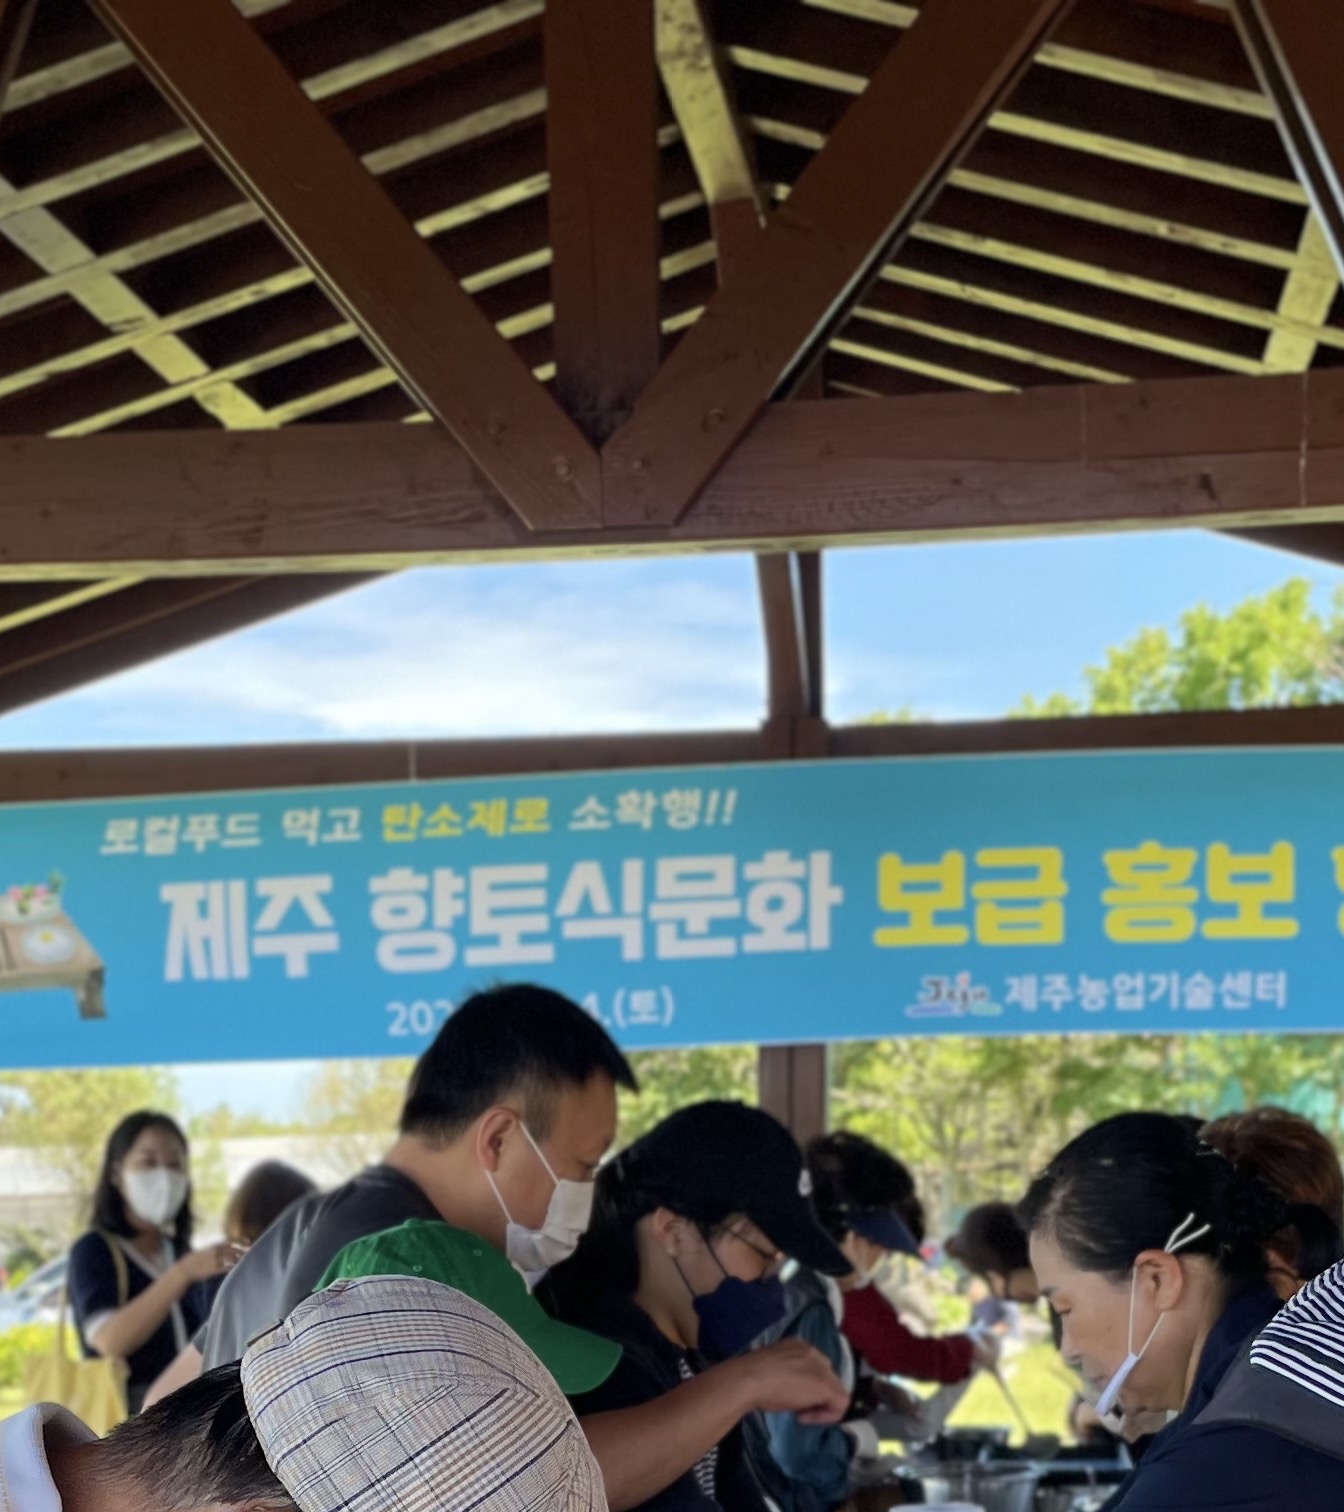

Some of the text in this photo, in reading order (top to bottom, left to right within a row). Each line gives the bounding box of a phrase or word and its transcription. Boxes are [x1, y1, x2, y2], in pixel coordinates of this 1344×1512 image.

[102, 790, 736, 855] 로컬푸드 먹고 탄소제로 소확행!!
[160, 875, 339, 981] 제주
[369, 851, 843, 972] 향토식문화
[874, 847, 1068, 947] 보급
[1102, 841, 1299, 943] 홍보
[1005, 972, 1286, 1011] 제주농업기술센터
